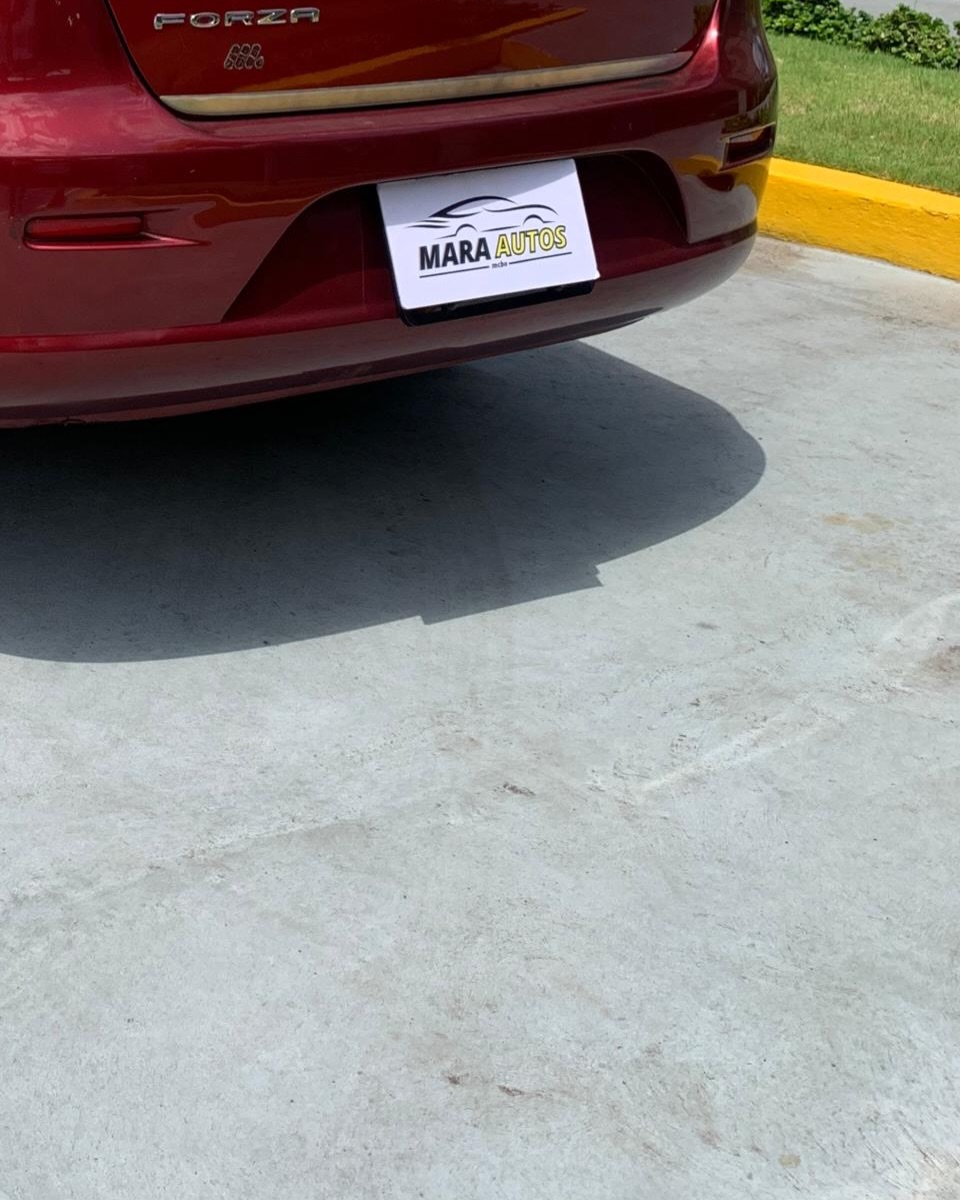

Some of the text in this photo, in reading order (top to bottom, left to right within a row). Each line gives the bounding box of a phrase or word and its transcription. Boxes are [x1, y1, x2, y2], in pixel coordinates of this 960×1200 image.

[153, 7, 321, 30] FORZA
[419, 225, 568, 271] MARA AUTOS
